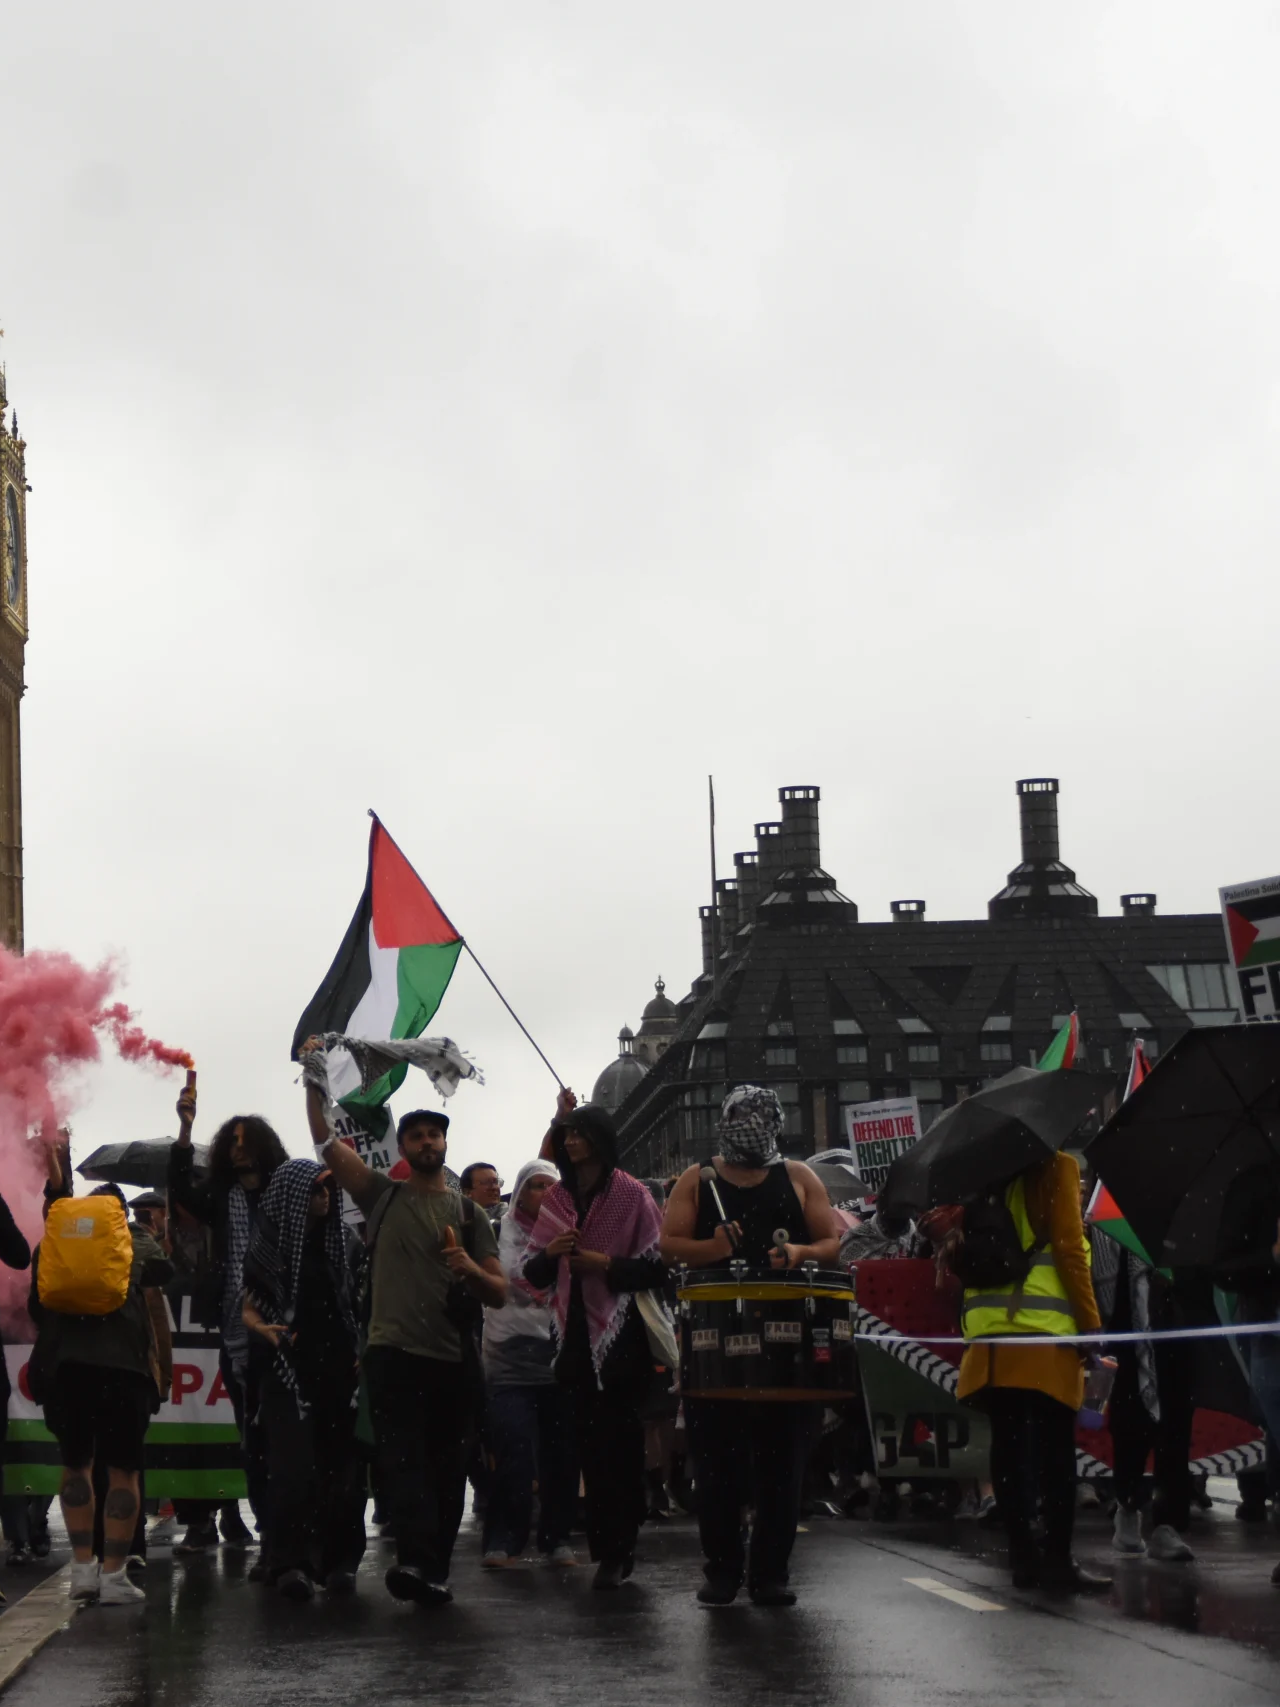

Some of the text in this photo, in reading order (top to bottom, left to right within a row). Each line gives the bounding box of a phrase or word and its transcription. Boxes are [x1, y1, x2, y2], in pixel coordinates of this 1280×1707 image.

[853, 1115, 915, 1142] DEFEND THE
[856, 1139, 899, 1169] RIGHT
[765, 1324, 799, 1333] FREE
